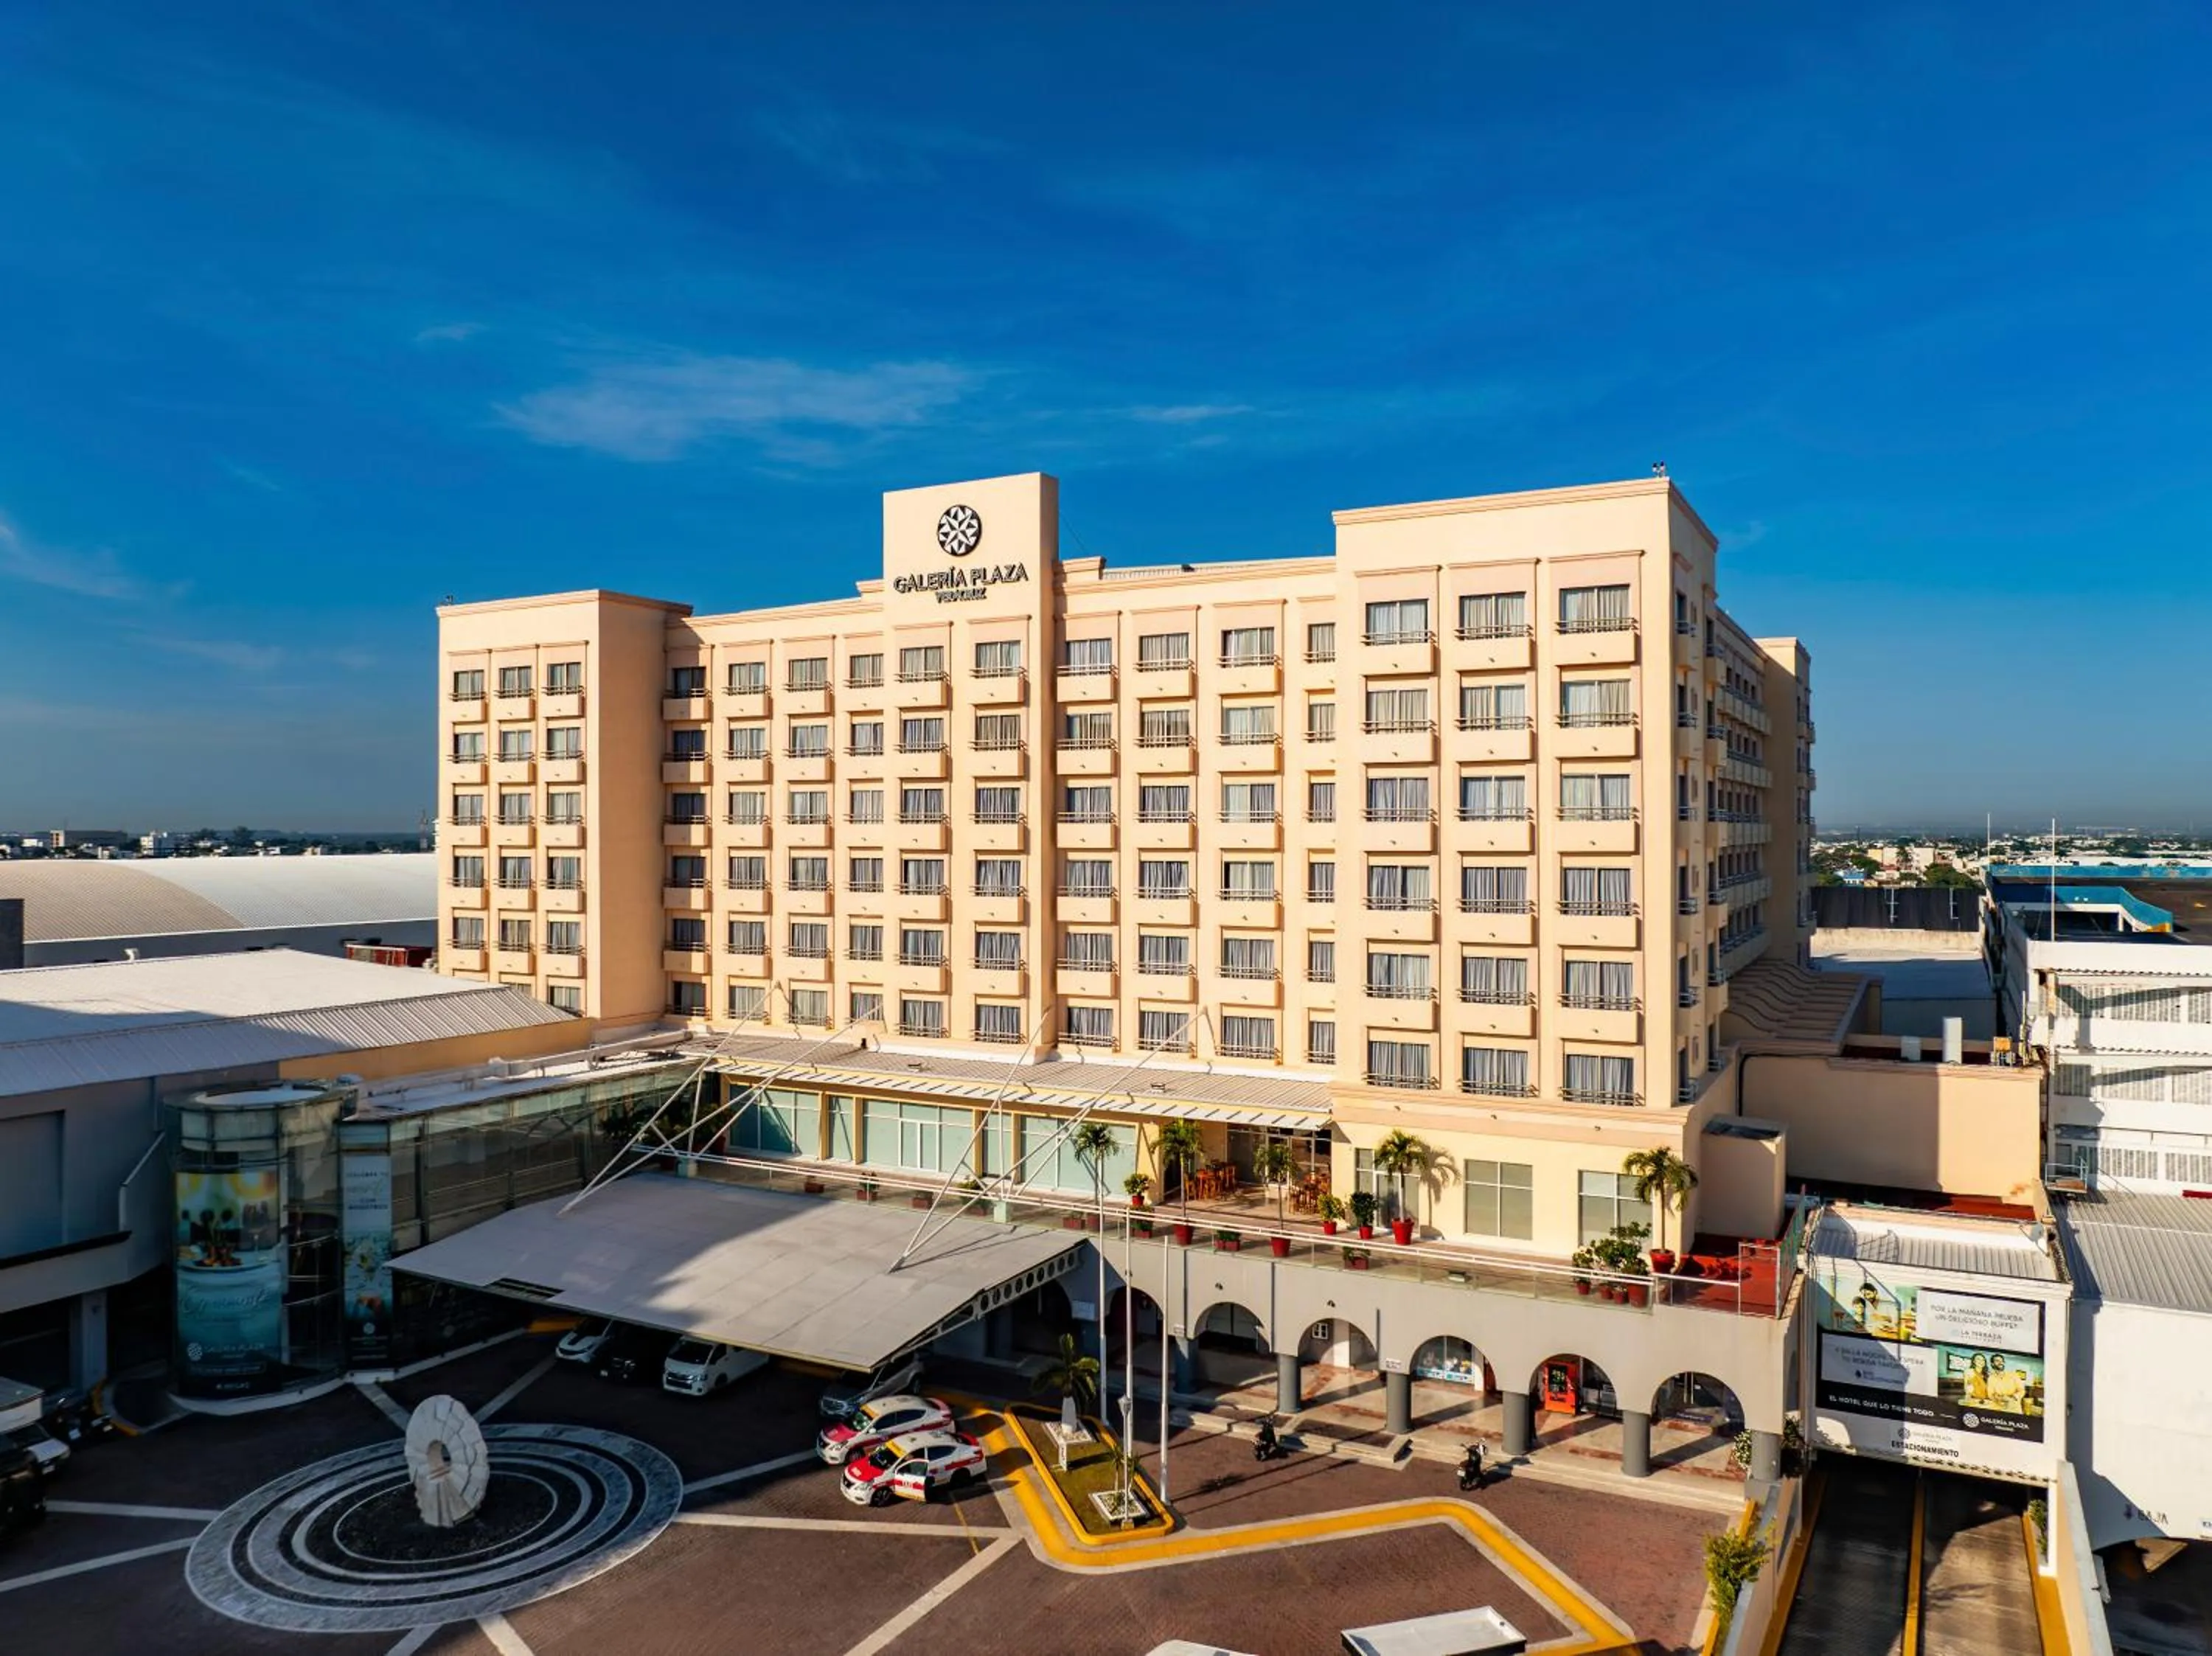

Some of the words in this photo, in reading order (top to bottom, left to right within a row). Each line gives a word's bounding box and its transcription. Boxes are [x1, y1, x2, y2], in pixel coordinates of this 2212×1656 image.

[894, 566, 967, 593] GALERÍA
[970, 563, 1029, 585] PLAZA
[1839, 1396, 1861, 1406] HOTEL
[1863, 1400, 1877, 1408] QUE
[1891, 1405, 1912, 1413] TIENE
[1913, 1408, 1934, 1416] TODO
[1980, 1416, 2008, 1426] GALERÍA
[2008, 1421, 2029, 1430] PLAZA
[1891, 1440, 1959, 1458] ESTACIONAMIENTO
